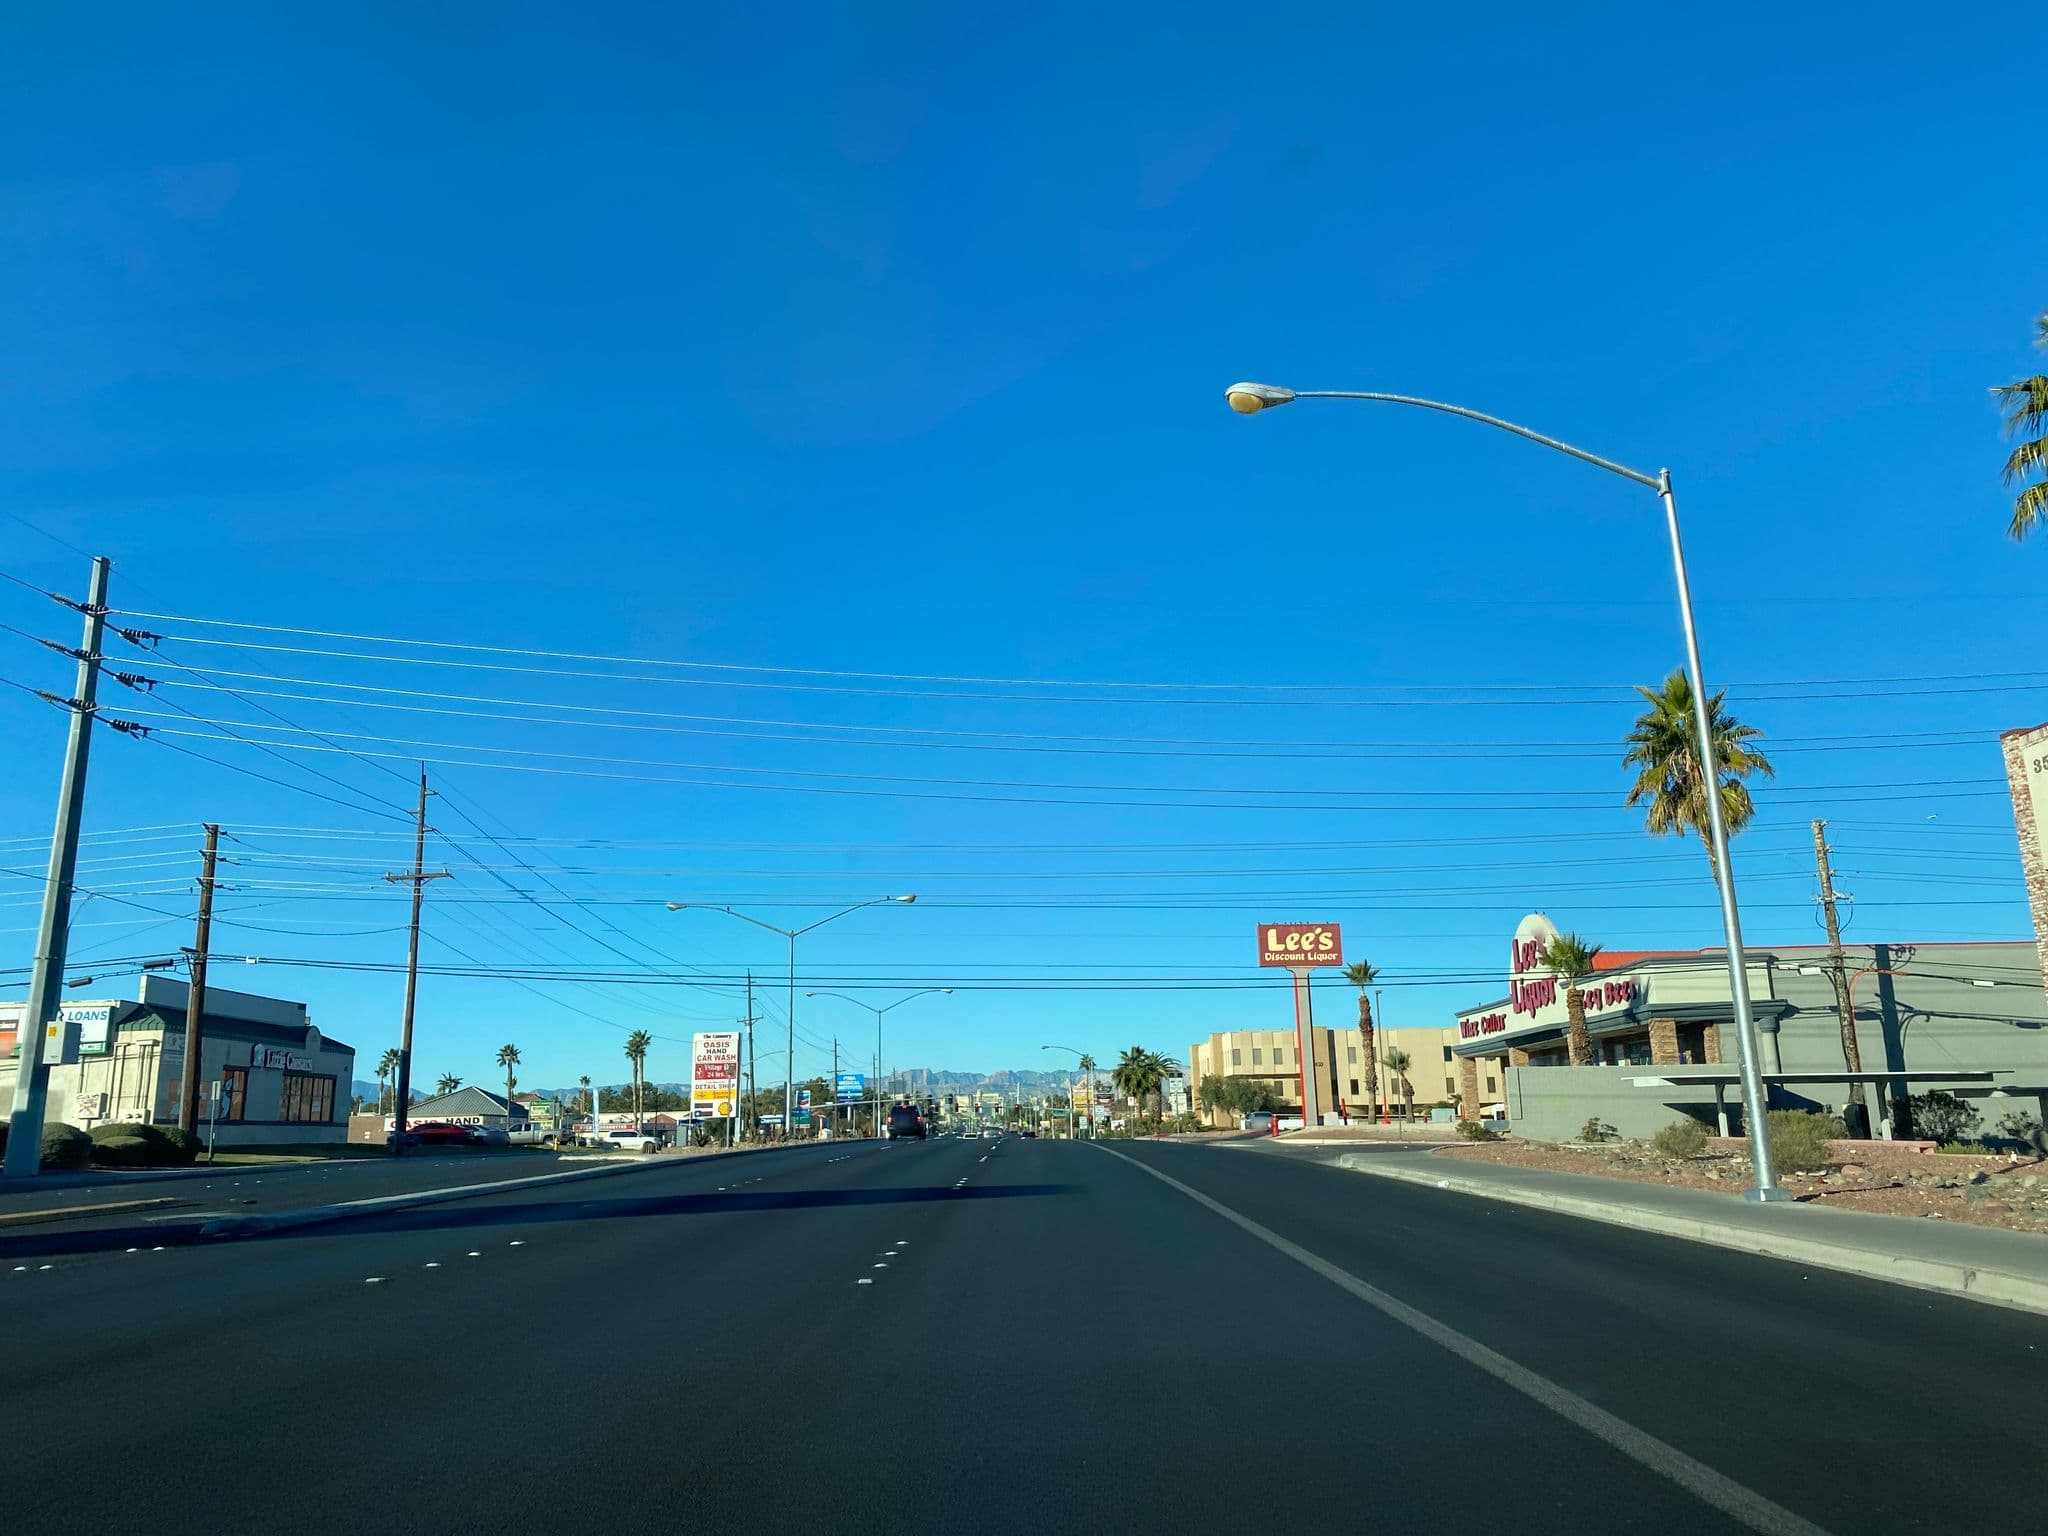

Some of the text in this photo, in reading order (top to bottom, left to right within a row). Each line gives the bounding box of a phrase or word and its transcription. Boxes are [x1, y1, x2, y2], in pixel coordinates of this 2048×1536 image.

[1268, 927, 1334, 952] Lee's
[1264, 952, 1338, 962] Discount Liquor
[1511, 974, 1558, 1019] Liquor
[68, 1010, 108, 1021] LOANS
[1460, 1013, 1507, 1038] Wine Cellar
[446, 1117, 480, 1125] HAND
